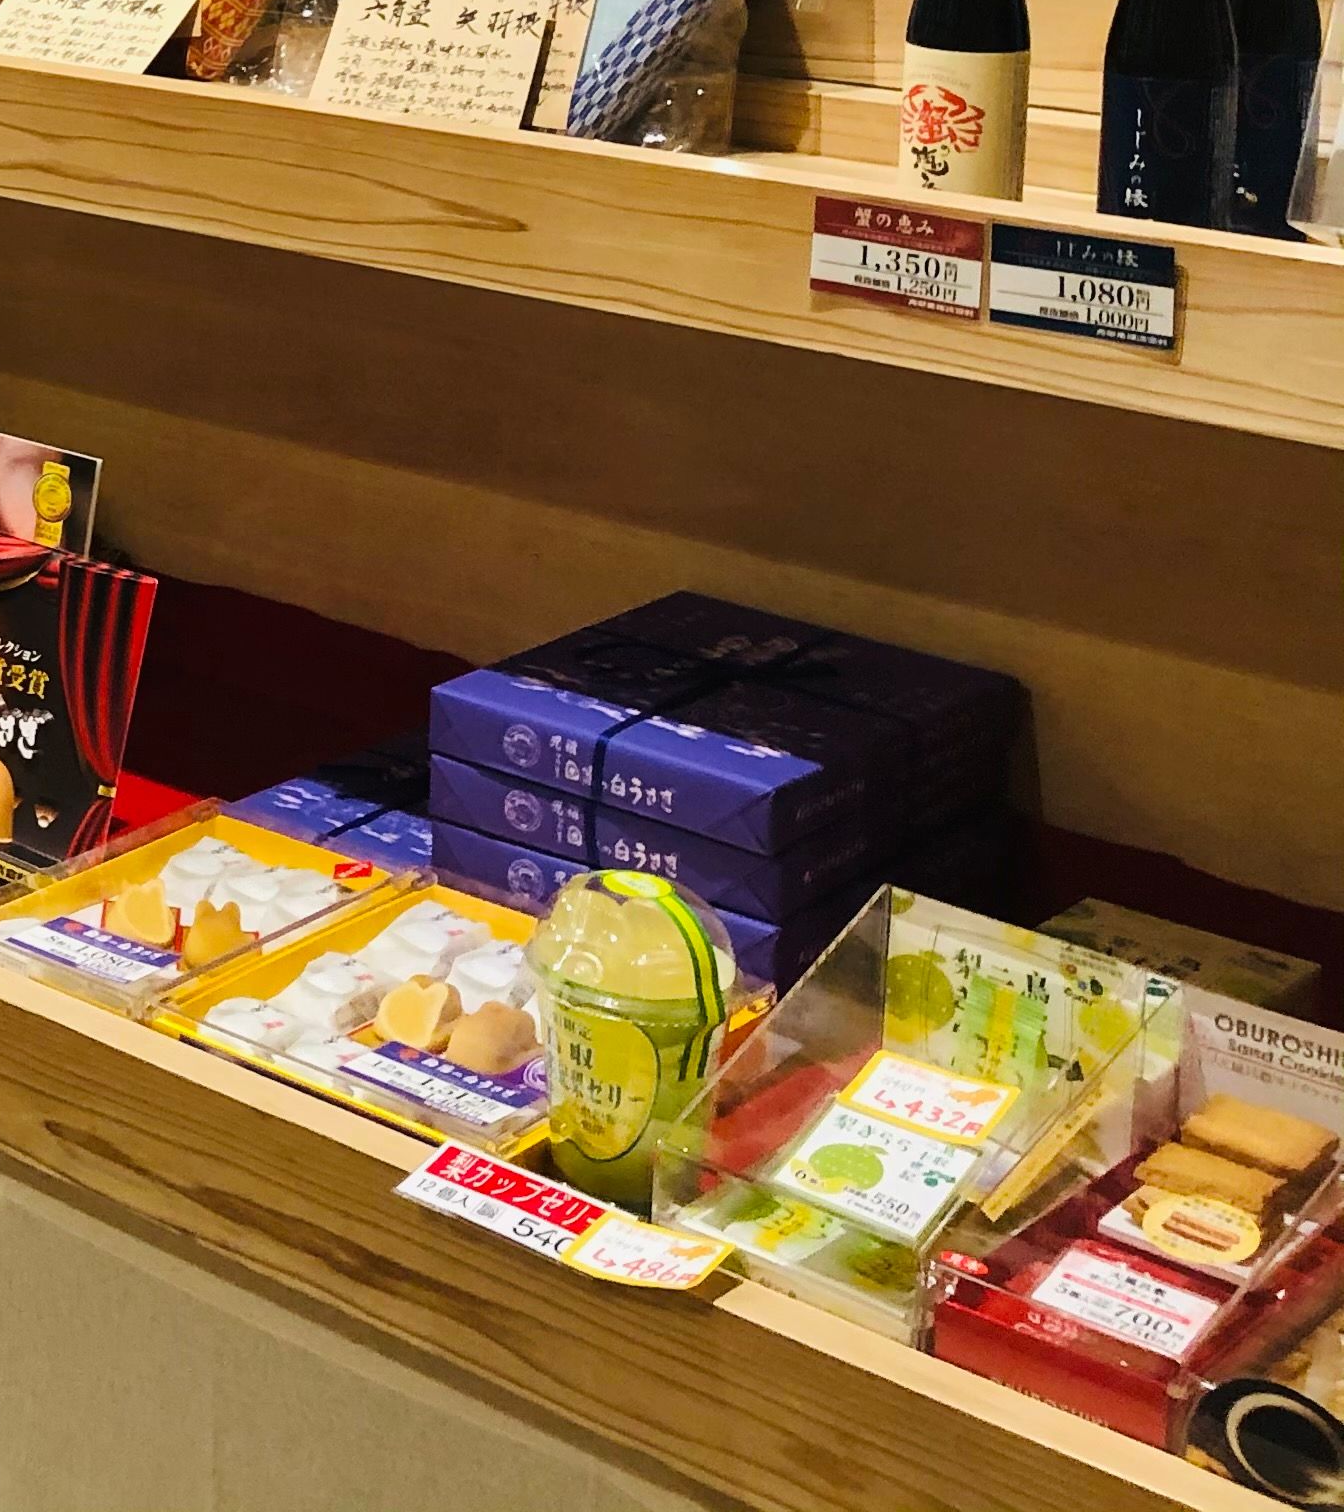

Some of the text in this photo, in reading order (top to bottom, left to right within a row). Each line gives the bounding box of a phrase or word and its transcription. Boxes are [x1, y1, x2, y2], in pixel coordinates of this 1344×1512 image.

[854, 206, 935, 236] 蟹の恵み
[1056, 240, 1139, 268] しじみの縁
[1086, 307, 1149, 333] 1,000円
[904, 1100, 985, 1136] 432円
[416, 1177, 470, 1209] 12個入
[622, 1258, 700, 1282] 486円
